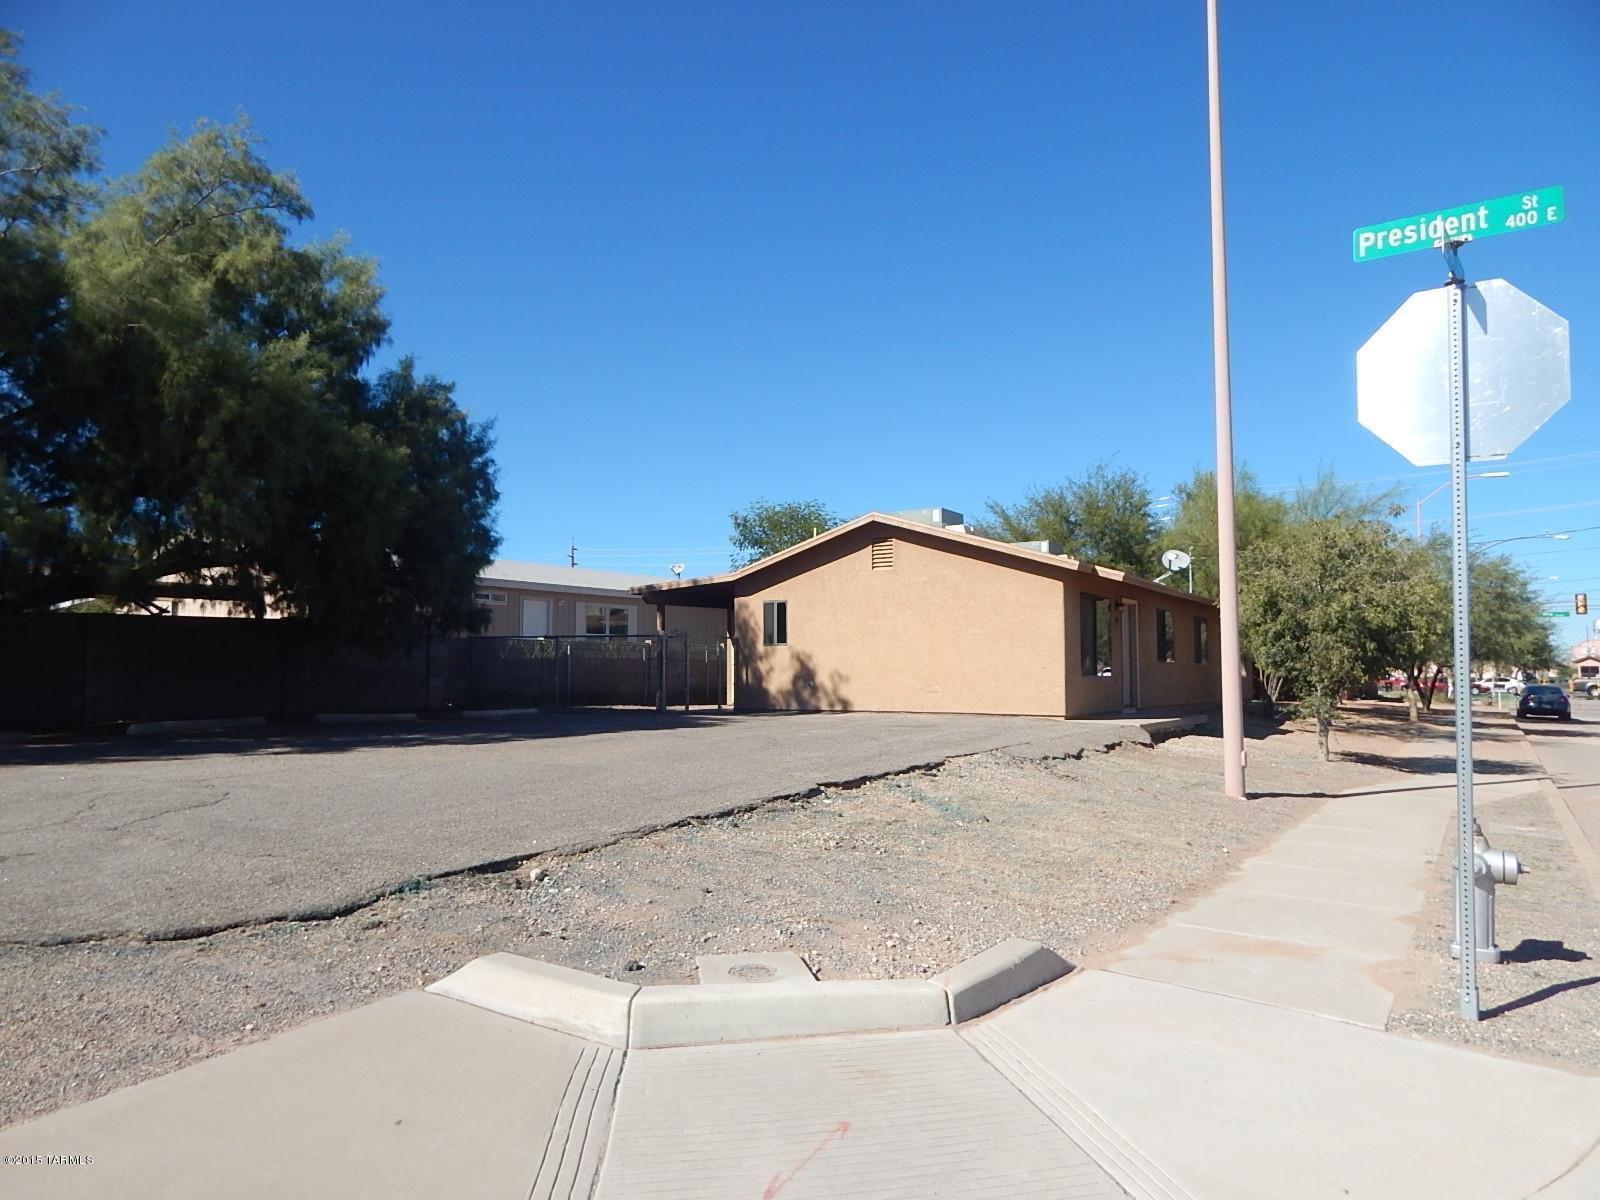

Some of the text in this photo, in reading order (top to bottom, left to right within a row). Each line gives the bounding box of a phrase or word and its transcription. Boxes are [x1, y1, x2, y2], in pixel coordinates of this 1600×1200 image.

[1359, 194, 1538, 257] President St
[1504, 206, 1557, 228] 400 E
